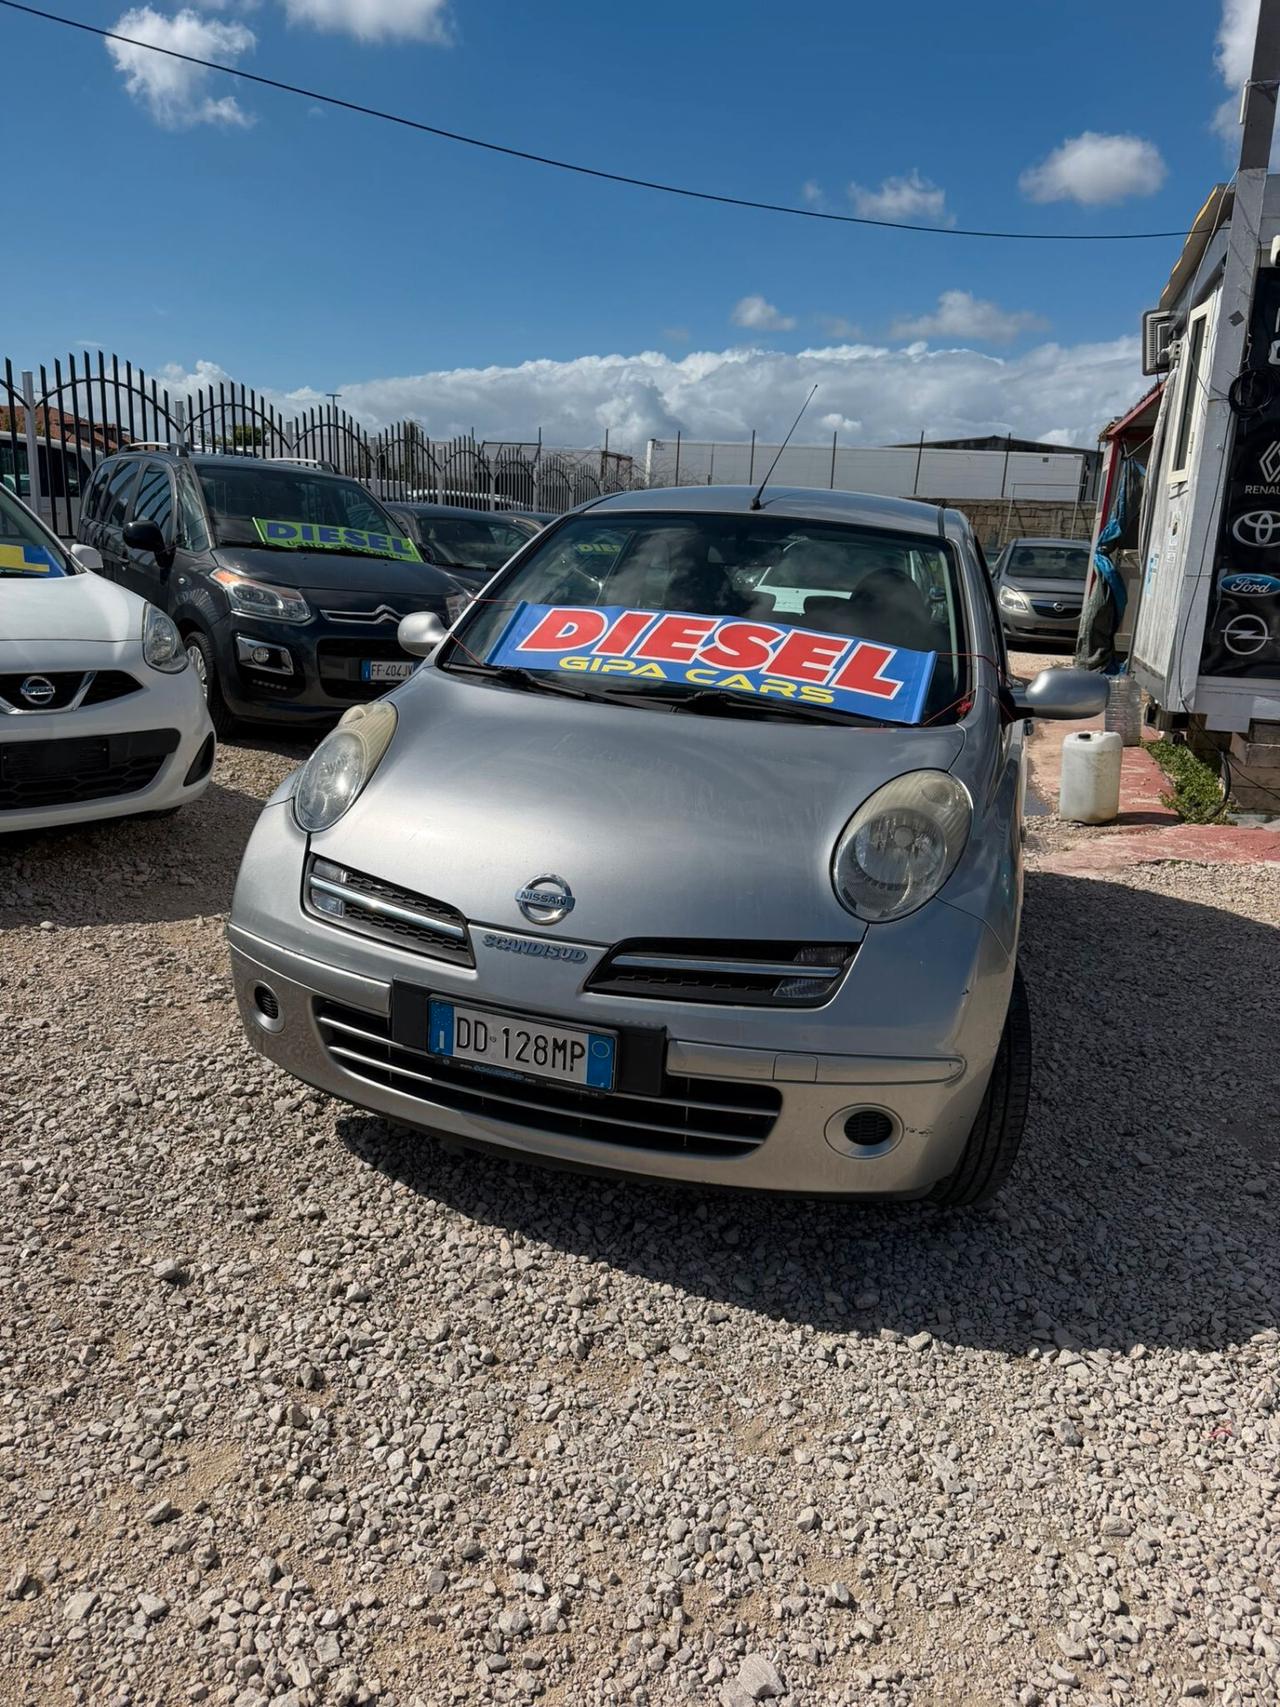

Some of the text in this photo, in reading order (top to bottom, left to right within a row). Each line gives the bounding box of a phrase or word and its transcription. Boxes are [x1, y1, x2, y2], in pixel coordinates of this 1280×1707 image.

[266, 522, 413, 555] DIESEL
[1230, 576, 1272, 593] Ford
[516, 608, 904, 700] DIESEL
[559, 655, 836, 704] GIPA CARS
[519, 890, 567, 907] NISSAN
[482, 934, 589, 964] SCANDISUD
